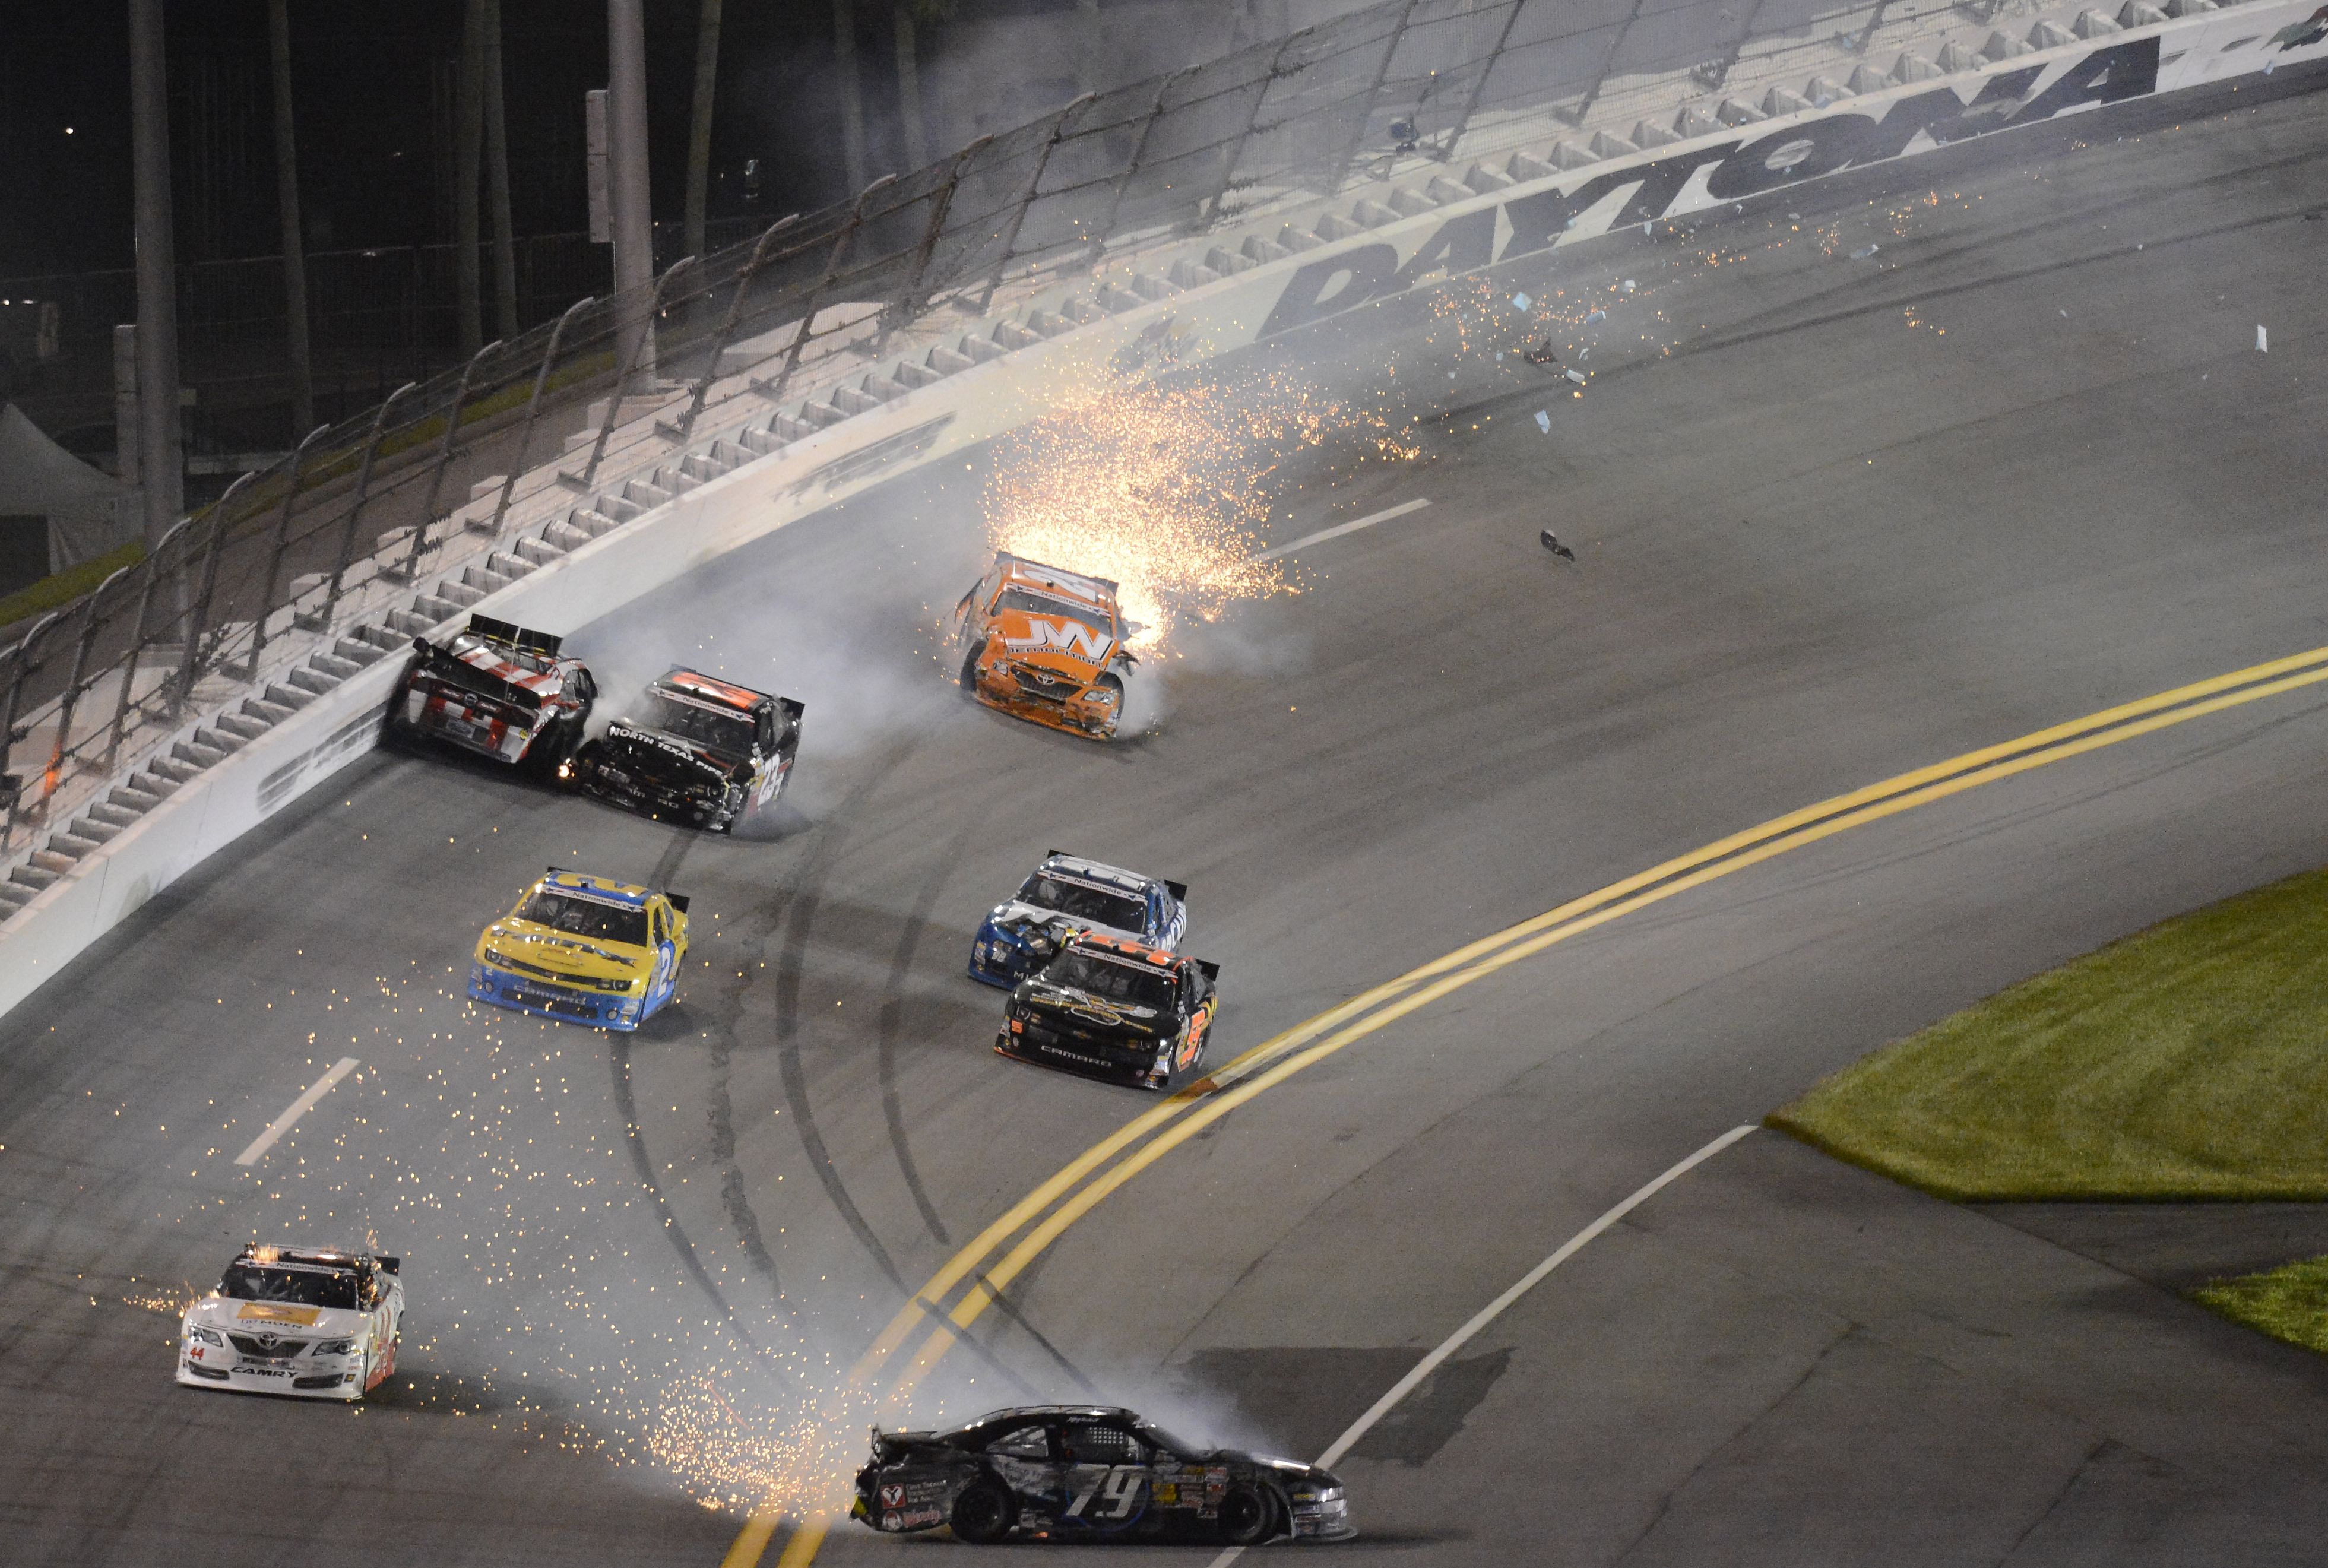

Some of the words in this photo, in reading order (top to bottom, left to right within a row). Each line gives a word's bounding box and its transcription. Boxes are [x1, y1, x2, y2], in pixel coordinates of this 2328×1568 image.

[1255, 36, 2161, 340] DAYTONA
[1041, 591, 1087, 609] Nationwide
[682, 696, 730, 715] Nationwide
[610, 726, 655, 745] NORTH
[658, 741, 695, 762] TEXAS
[1073, 878, 1122, 895] Nationwide
[572, 891, 621, 907] Nationwide
[1104, 954, 1151, 971] Nationwide
[189, 1347, 205, 1360] 44
[230, 1366, 299, 1378] CAMRY
[1065, 1463, 1146, 1518] 79
